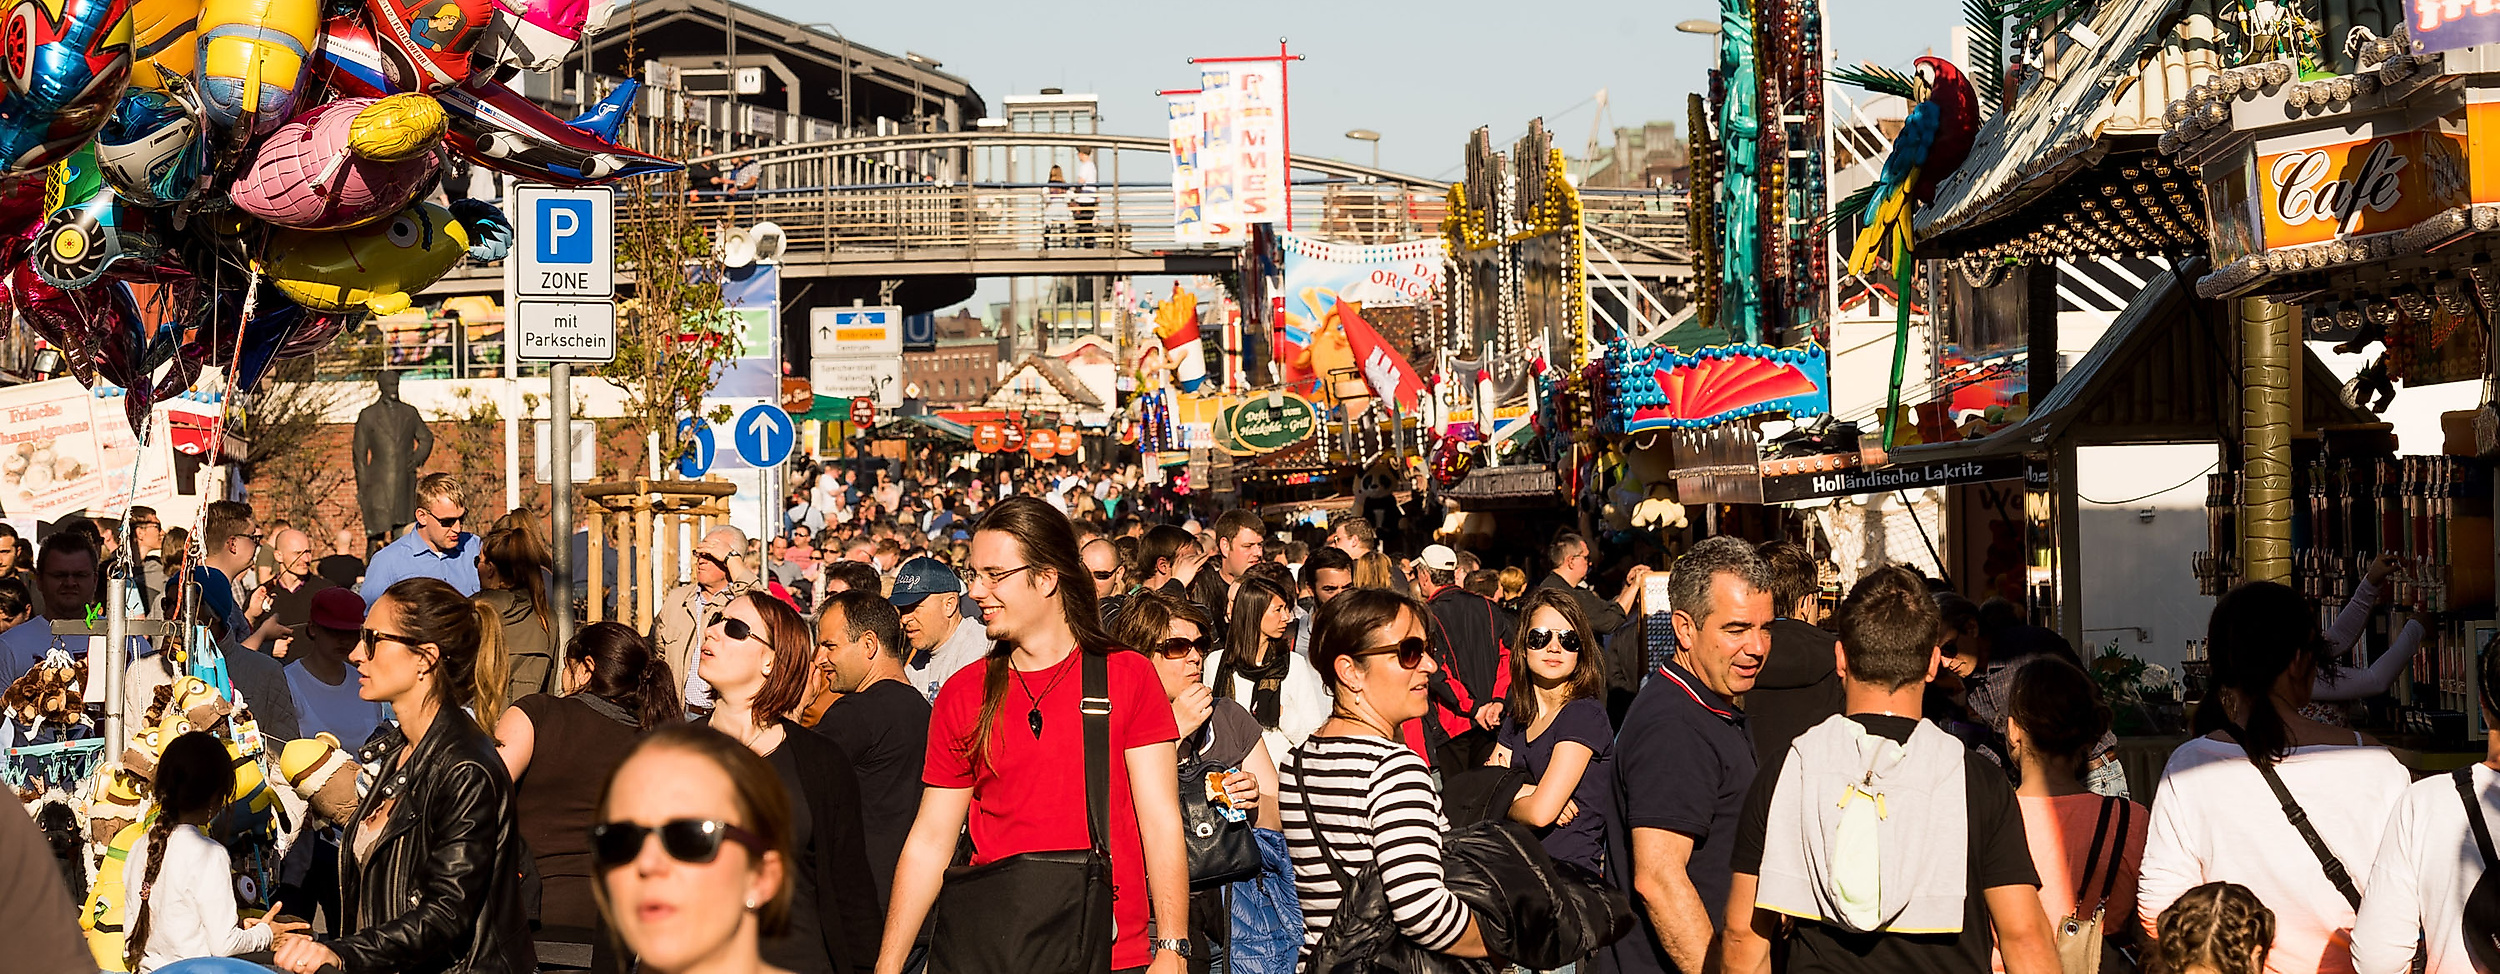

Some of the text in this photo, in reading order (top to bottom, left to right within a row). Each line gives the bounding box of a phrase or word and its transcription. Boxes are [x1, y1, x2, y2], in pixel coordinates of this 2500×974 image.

[392, 20, 428, 65] FEUERWEHR
[2271, 138, 2409, 239] Café
[550, 208, 579, 255] P
[541, 272, 588, 289] ZONE
[1414, 263, 1440, 284] DA
[554, 314, 578, 328] mit
[907, 315, 931, 343] U
[526, 332, 606, 347] Parkschein
[0, 421, 90, 445] hampignons
[1289, 416, 1311, 433] Grill
[1812, 461, 1983, 494] Holländische Lakritz
